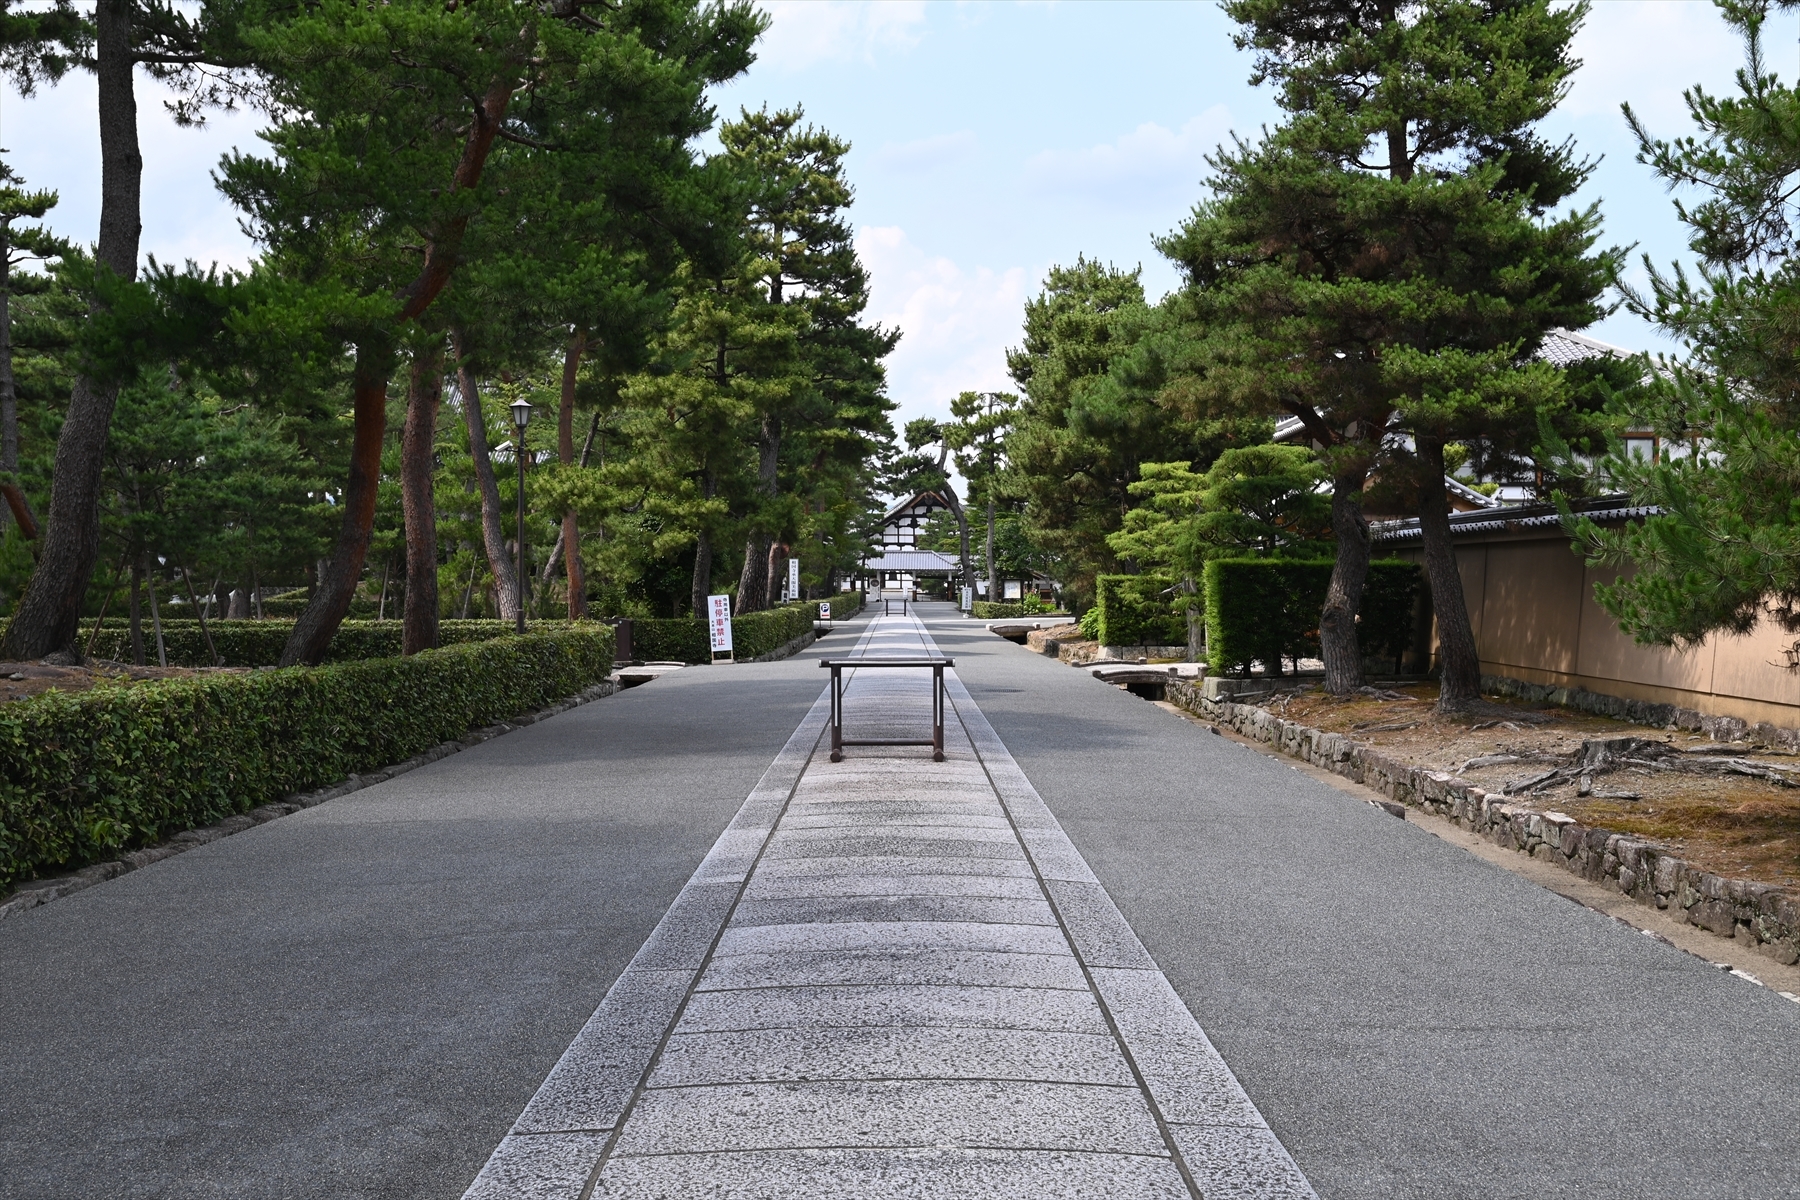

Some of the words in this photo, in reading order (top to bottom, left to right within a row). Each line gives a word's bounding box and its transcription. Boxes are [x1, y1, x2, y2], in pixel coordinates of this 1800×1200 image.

[714, 599, 725, 646] 駐停車禁止
